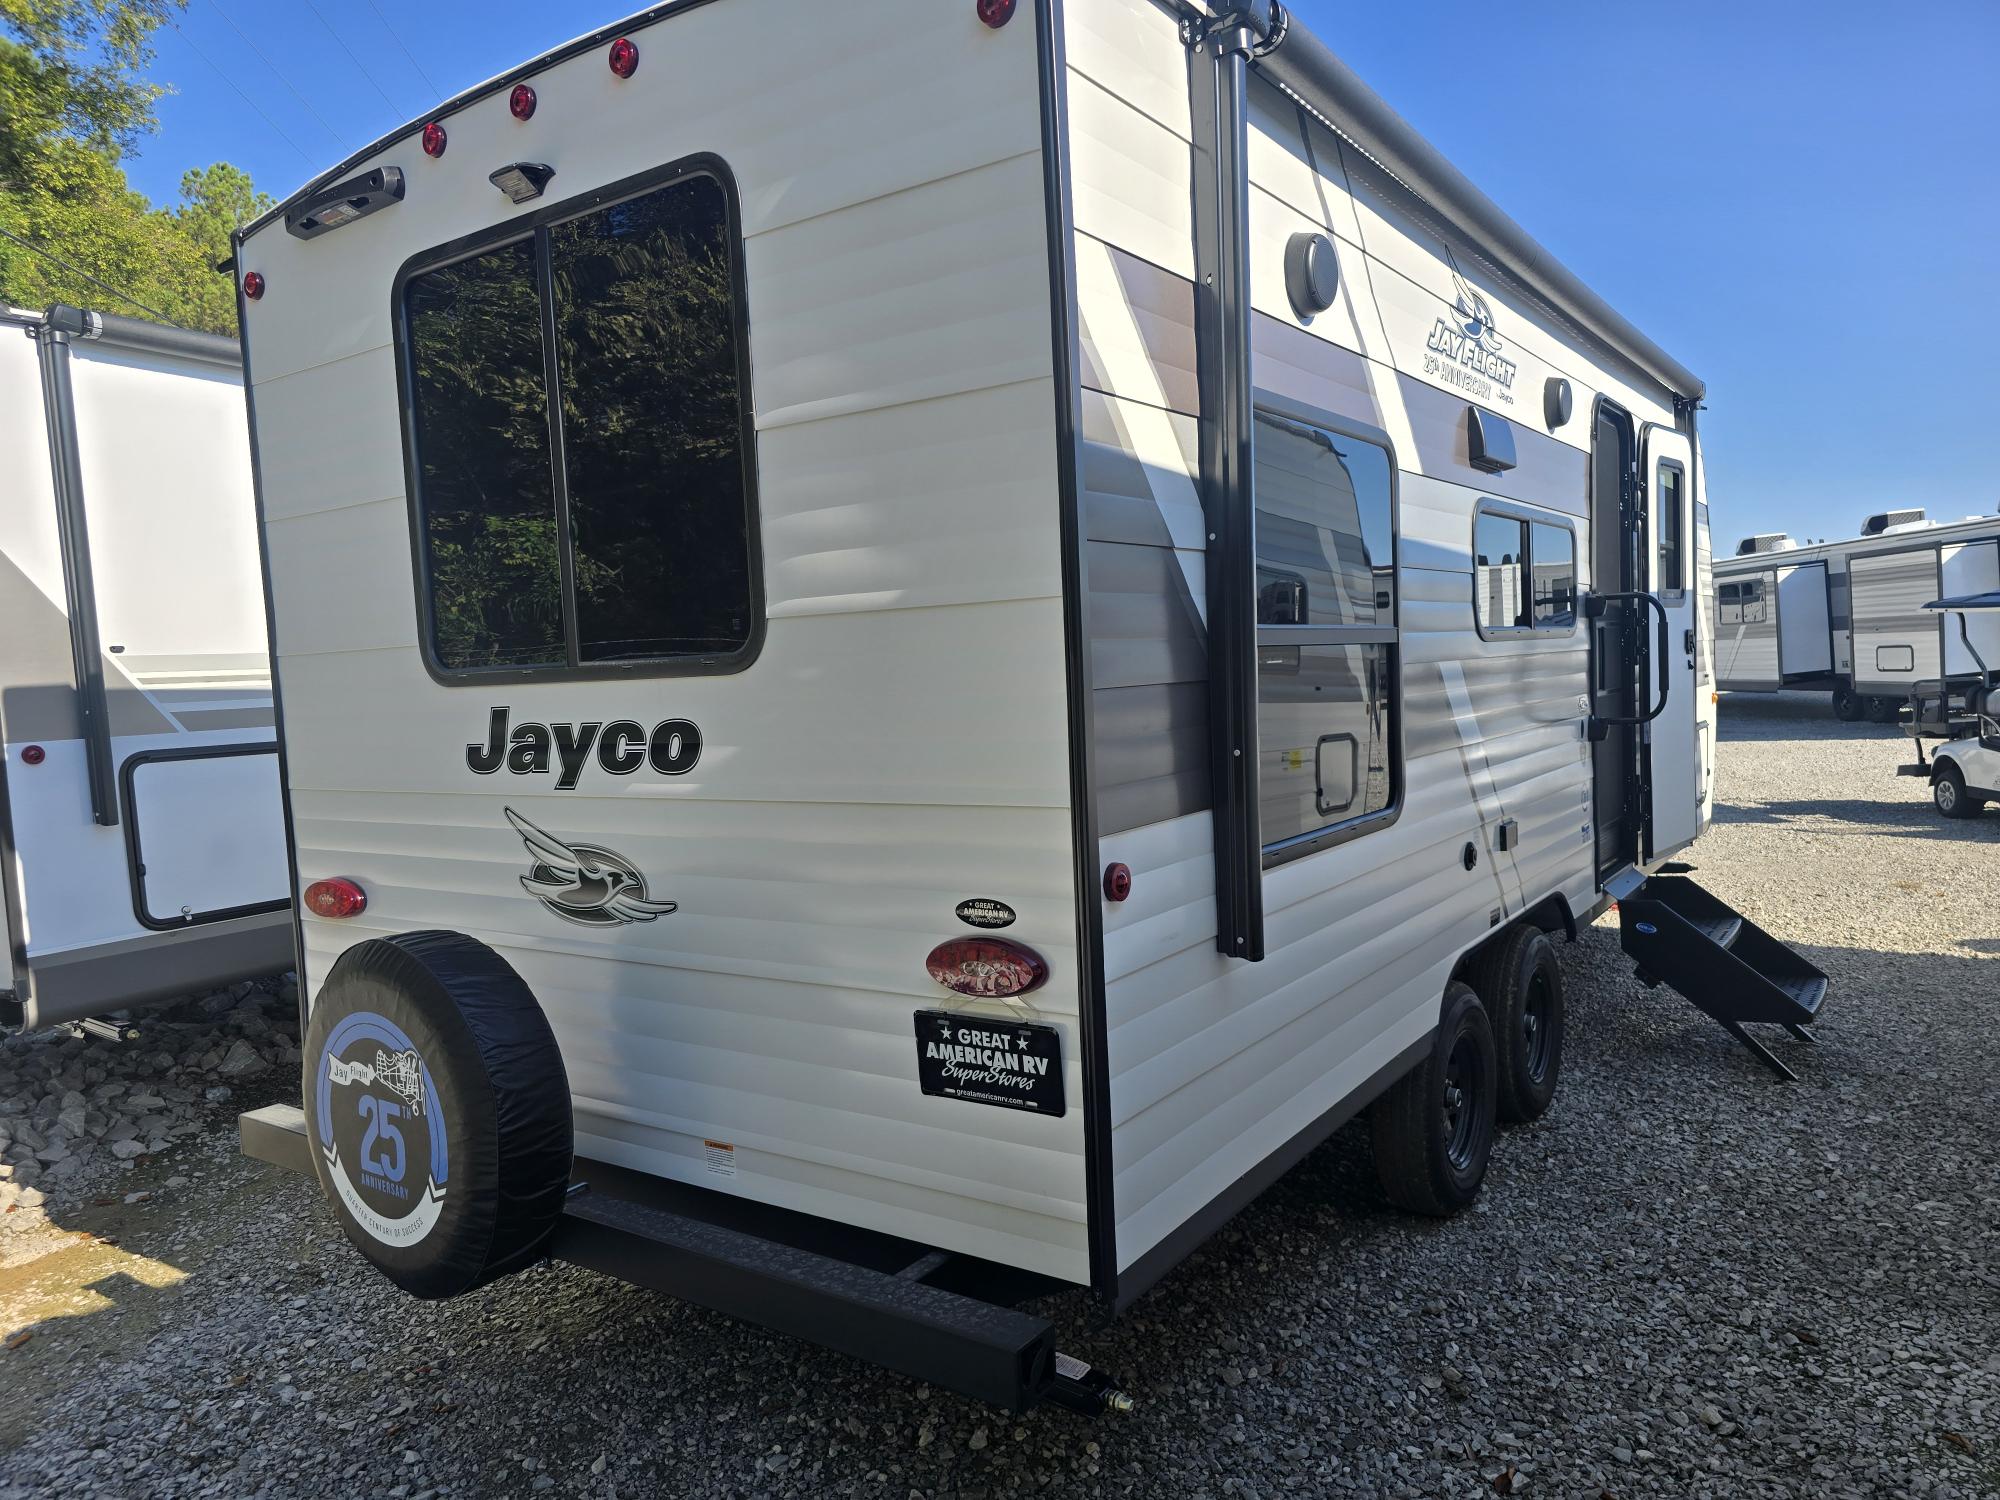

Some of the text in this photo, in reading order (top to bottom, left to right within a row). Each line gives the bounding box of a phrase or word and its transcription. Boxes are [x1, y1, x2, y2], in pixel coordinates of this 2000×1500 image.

[1427, 317, 1517, 389] JAY FLIGHT
[1440, 361, 1492, 401] ANNIVERSARY
[465, 705, 703, 790] Jayco
[963, 907, 999, 918] AMERICAN
[974, 902, 995, 910] GREAT
[957, 1028, 1011, 1050] GREAT
[926, 1041, 1049, 1076] AMERICAN RV
[334, 1065, 368, 1082] Jay Flight
[941, 1059, 1036, 1090] SuperStores
[956, 1088, 1024, 1106] greatamericanrv.com
[361, 1173, 409, 1200] ANNIVERSARY
[345, 1189, 424, 1238] QUARTER CENTURY OF SUCCESS
